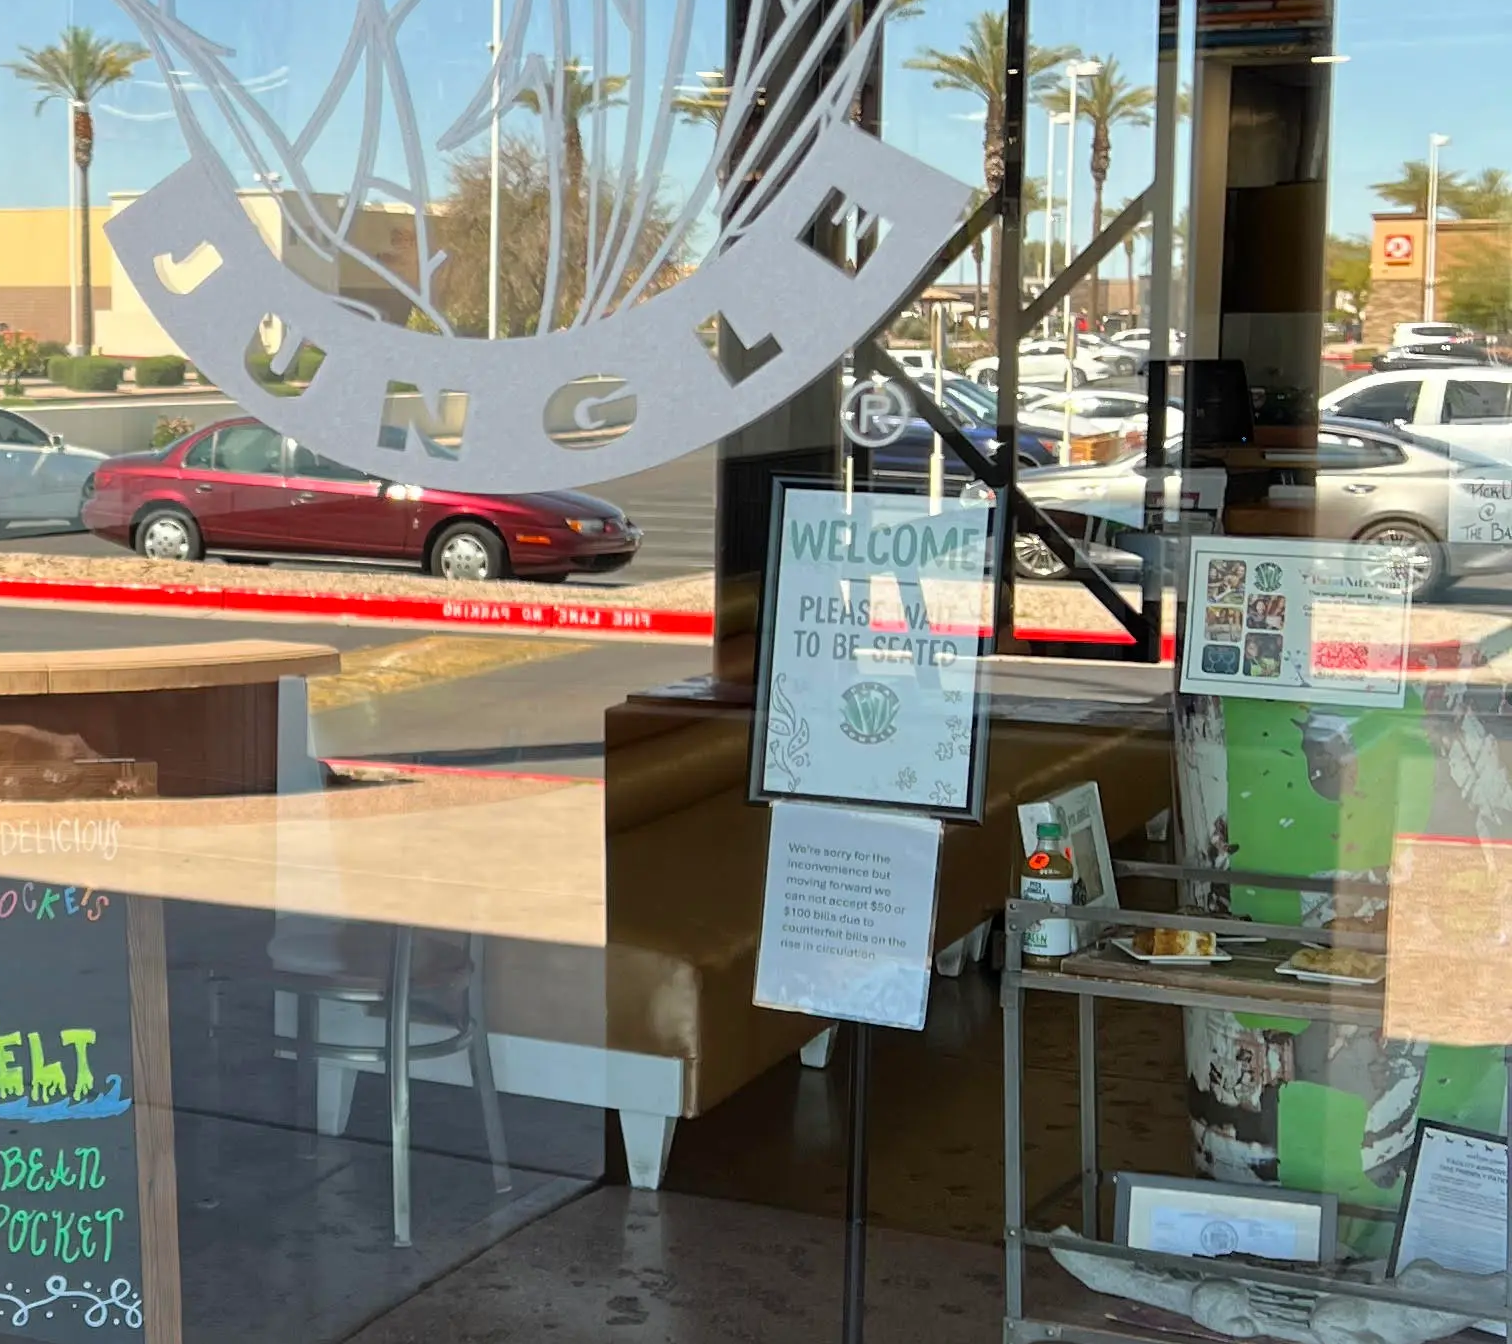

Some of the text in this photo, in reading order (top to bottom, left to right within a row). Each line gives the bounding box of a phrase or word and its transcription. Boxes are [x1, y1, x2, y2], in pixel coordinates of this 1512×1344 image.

[152, 185, 894, 462] JUNGLE
[1459, 523, 1483, 541] THE
[791, 519, 980, 571] WELCOME
[794, 631, 958, 667] TO BE SEATED
[0, 817, 123, 861] DELICIOUS
[824, 848, 851, 862] sorry
[854, 851, 870, 862] for
[872, 853, 891, 865] the
[786, 876, 827, 890] moving
[829, 880, 872, 895] forward
[872, 869, 891, 880] but
[784, 892, 906, 916] can not accept $50 or
[813, 910, 837, 923] bills
[839, 914, 861, 926] due
[863, 917, 875, 928] to
[781, 939, 801, 950] rise
[803, 942, 814, 951] in
[782, 923, 907, 949] counterfeit bills on the
[0, 1146, 108, 1192] BEAN
